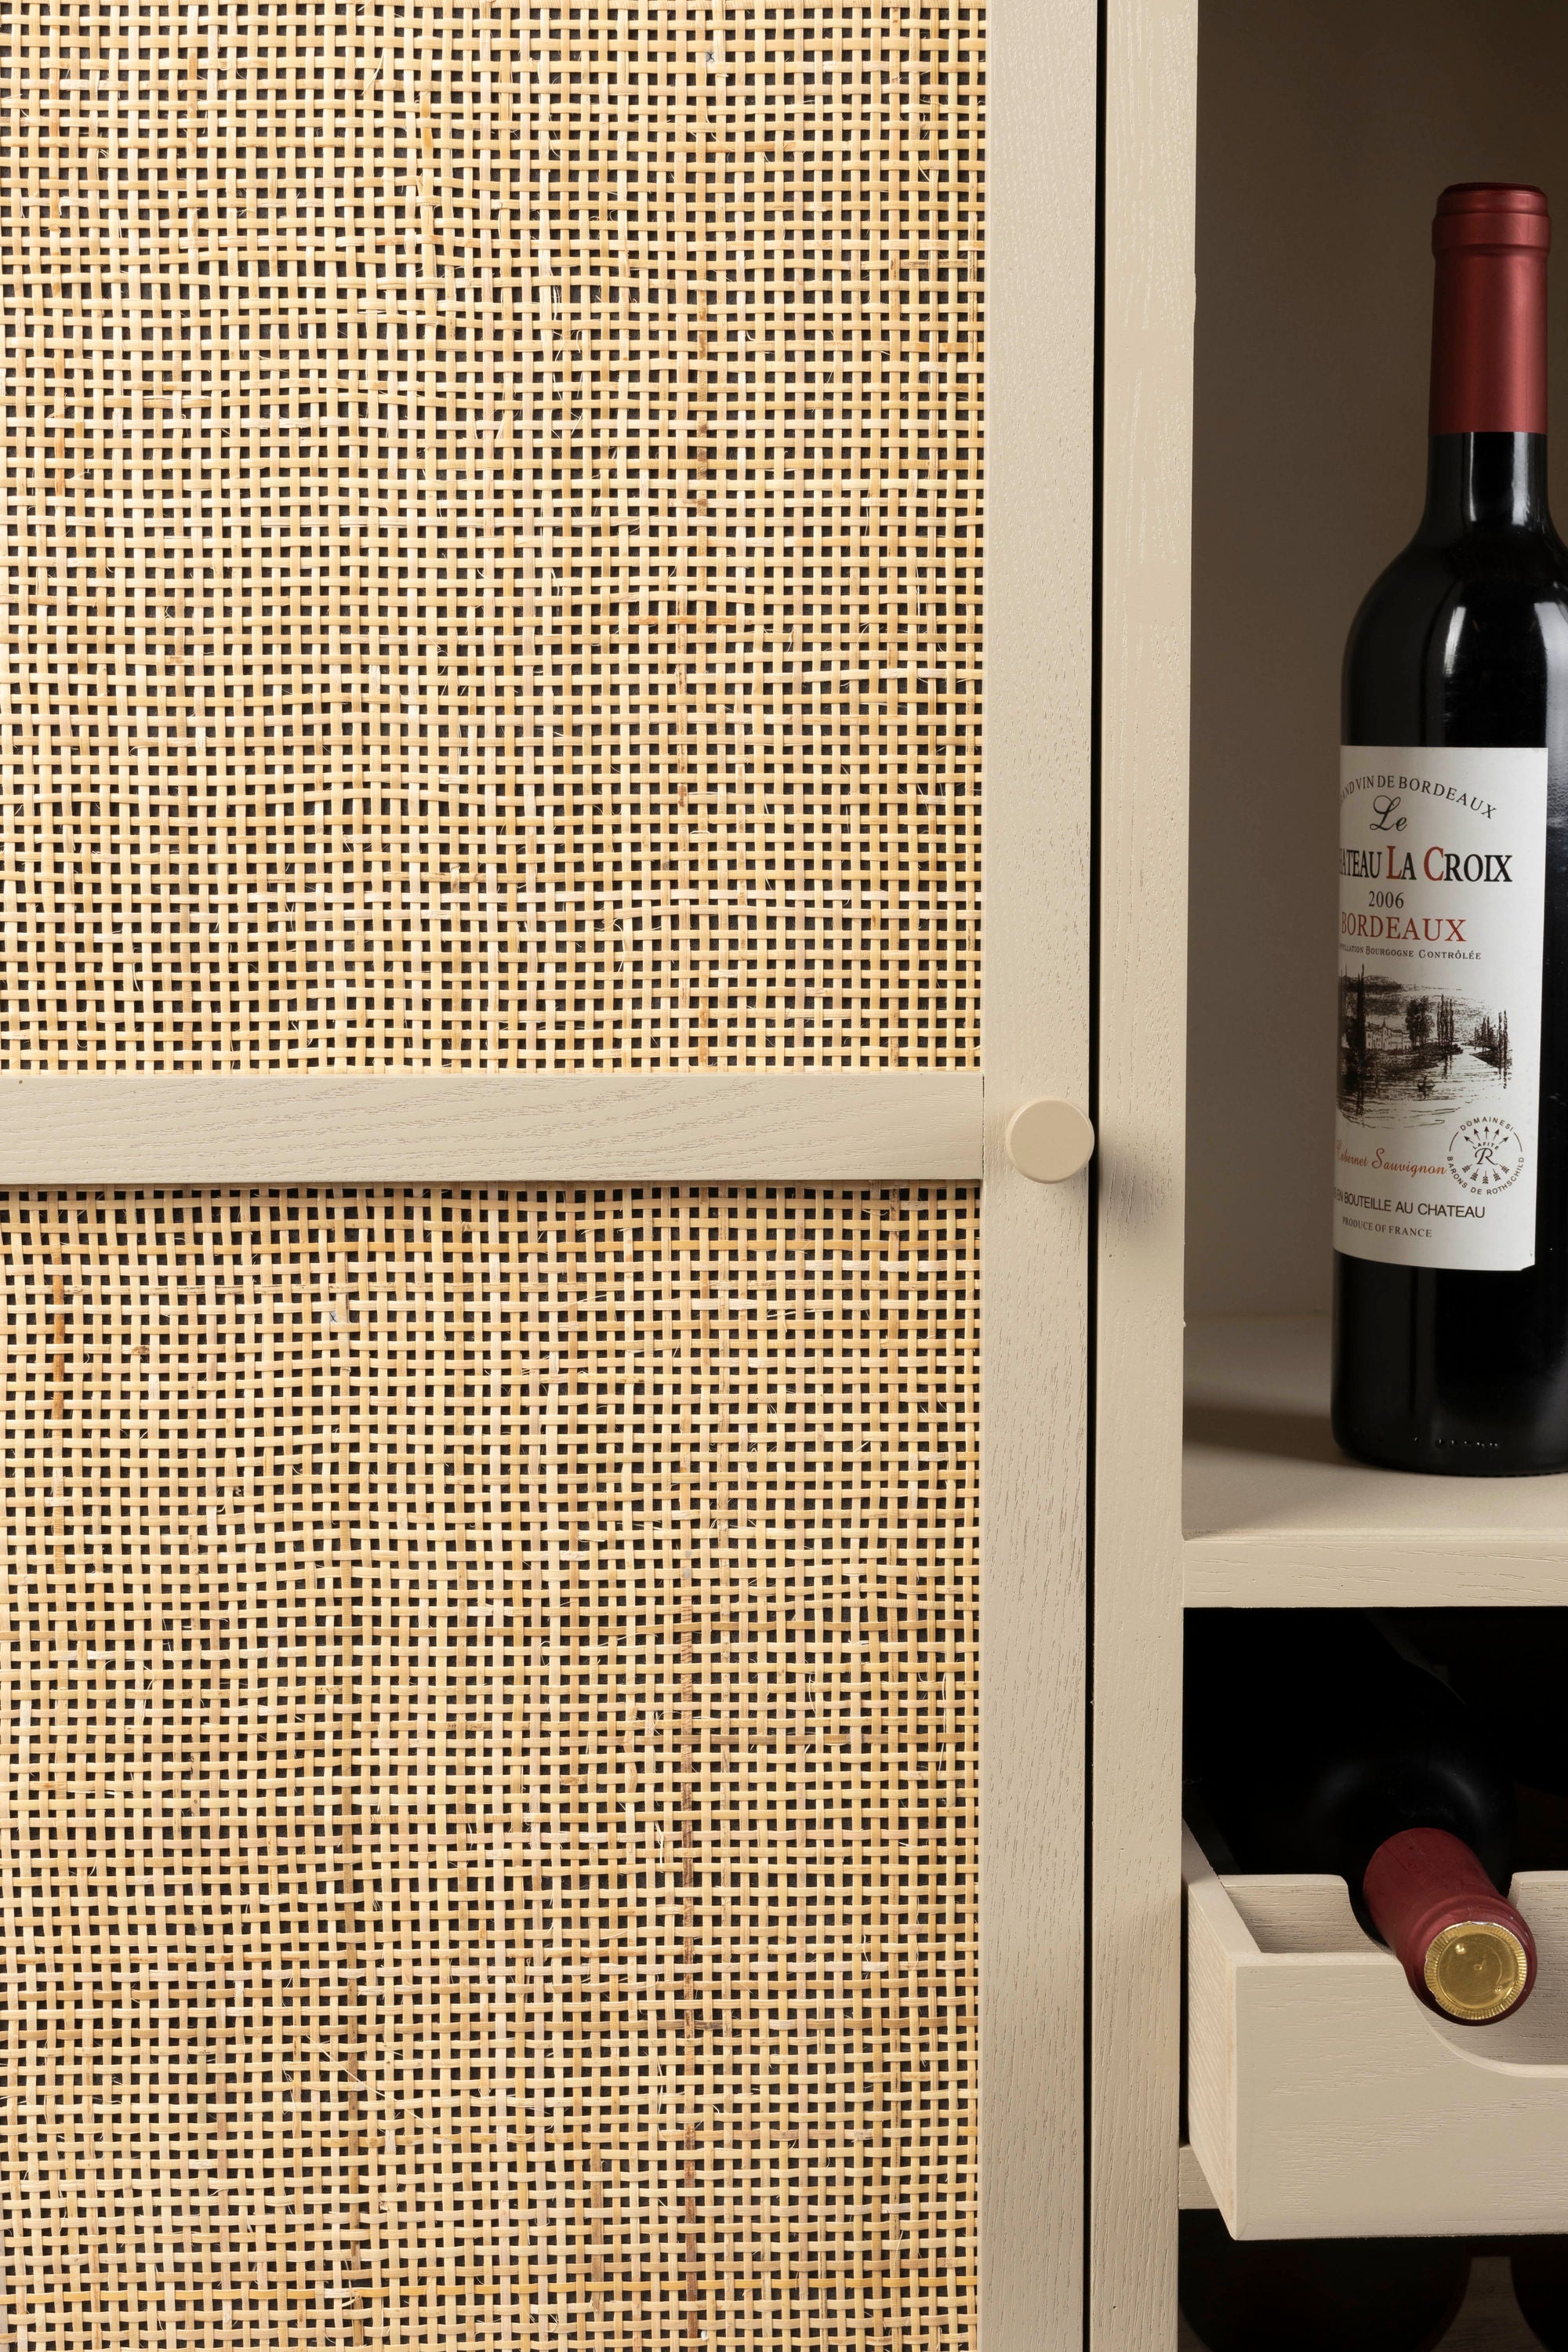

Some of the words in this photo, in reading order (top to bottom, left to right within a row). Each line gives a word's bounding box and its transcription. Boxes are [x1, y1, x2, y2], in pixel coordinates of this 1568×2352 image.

[1356, 775, 1374, 790] VIN
[1377, 775, 1395, 788] DE
[1399, 776, 1497, 820] BORDEAUX
[1369, 794, 1408, 832] Le
[1385, 845, 1417, 880] LA
[1423, 846, 1513, 883] CROIX
[1368, 890, 1404, 909] 2006
[1341, 911, 1467, 942] BORDEAUX
[1366, 946, 1414, 957] BOURGOGNE
[1472, 1142, 1500, 1151] LAFITE
[1371, 1147, 1448, 1178] Sauvignon
[1447, 1156, 1468, 1189] BARONS
[1470, 1186, 1483, 1196] DE
[1486, 1156, 1525, 1196] ROTHSCHILD
[1344, 1191, 1392, 1212] BOUTEILLE
[1395, 1200, 1414, 1214] AU
[1417, 1203, 1486, 1218] CHATEAU
[1342, 1216, 1374, 1231] PRODUCE
[1374, 1223, 1387, 1233] OF
[1388, 1225, 1433, 1238] FRANCE
